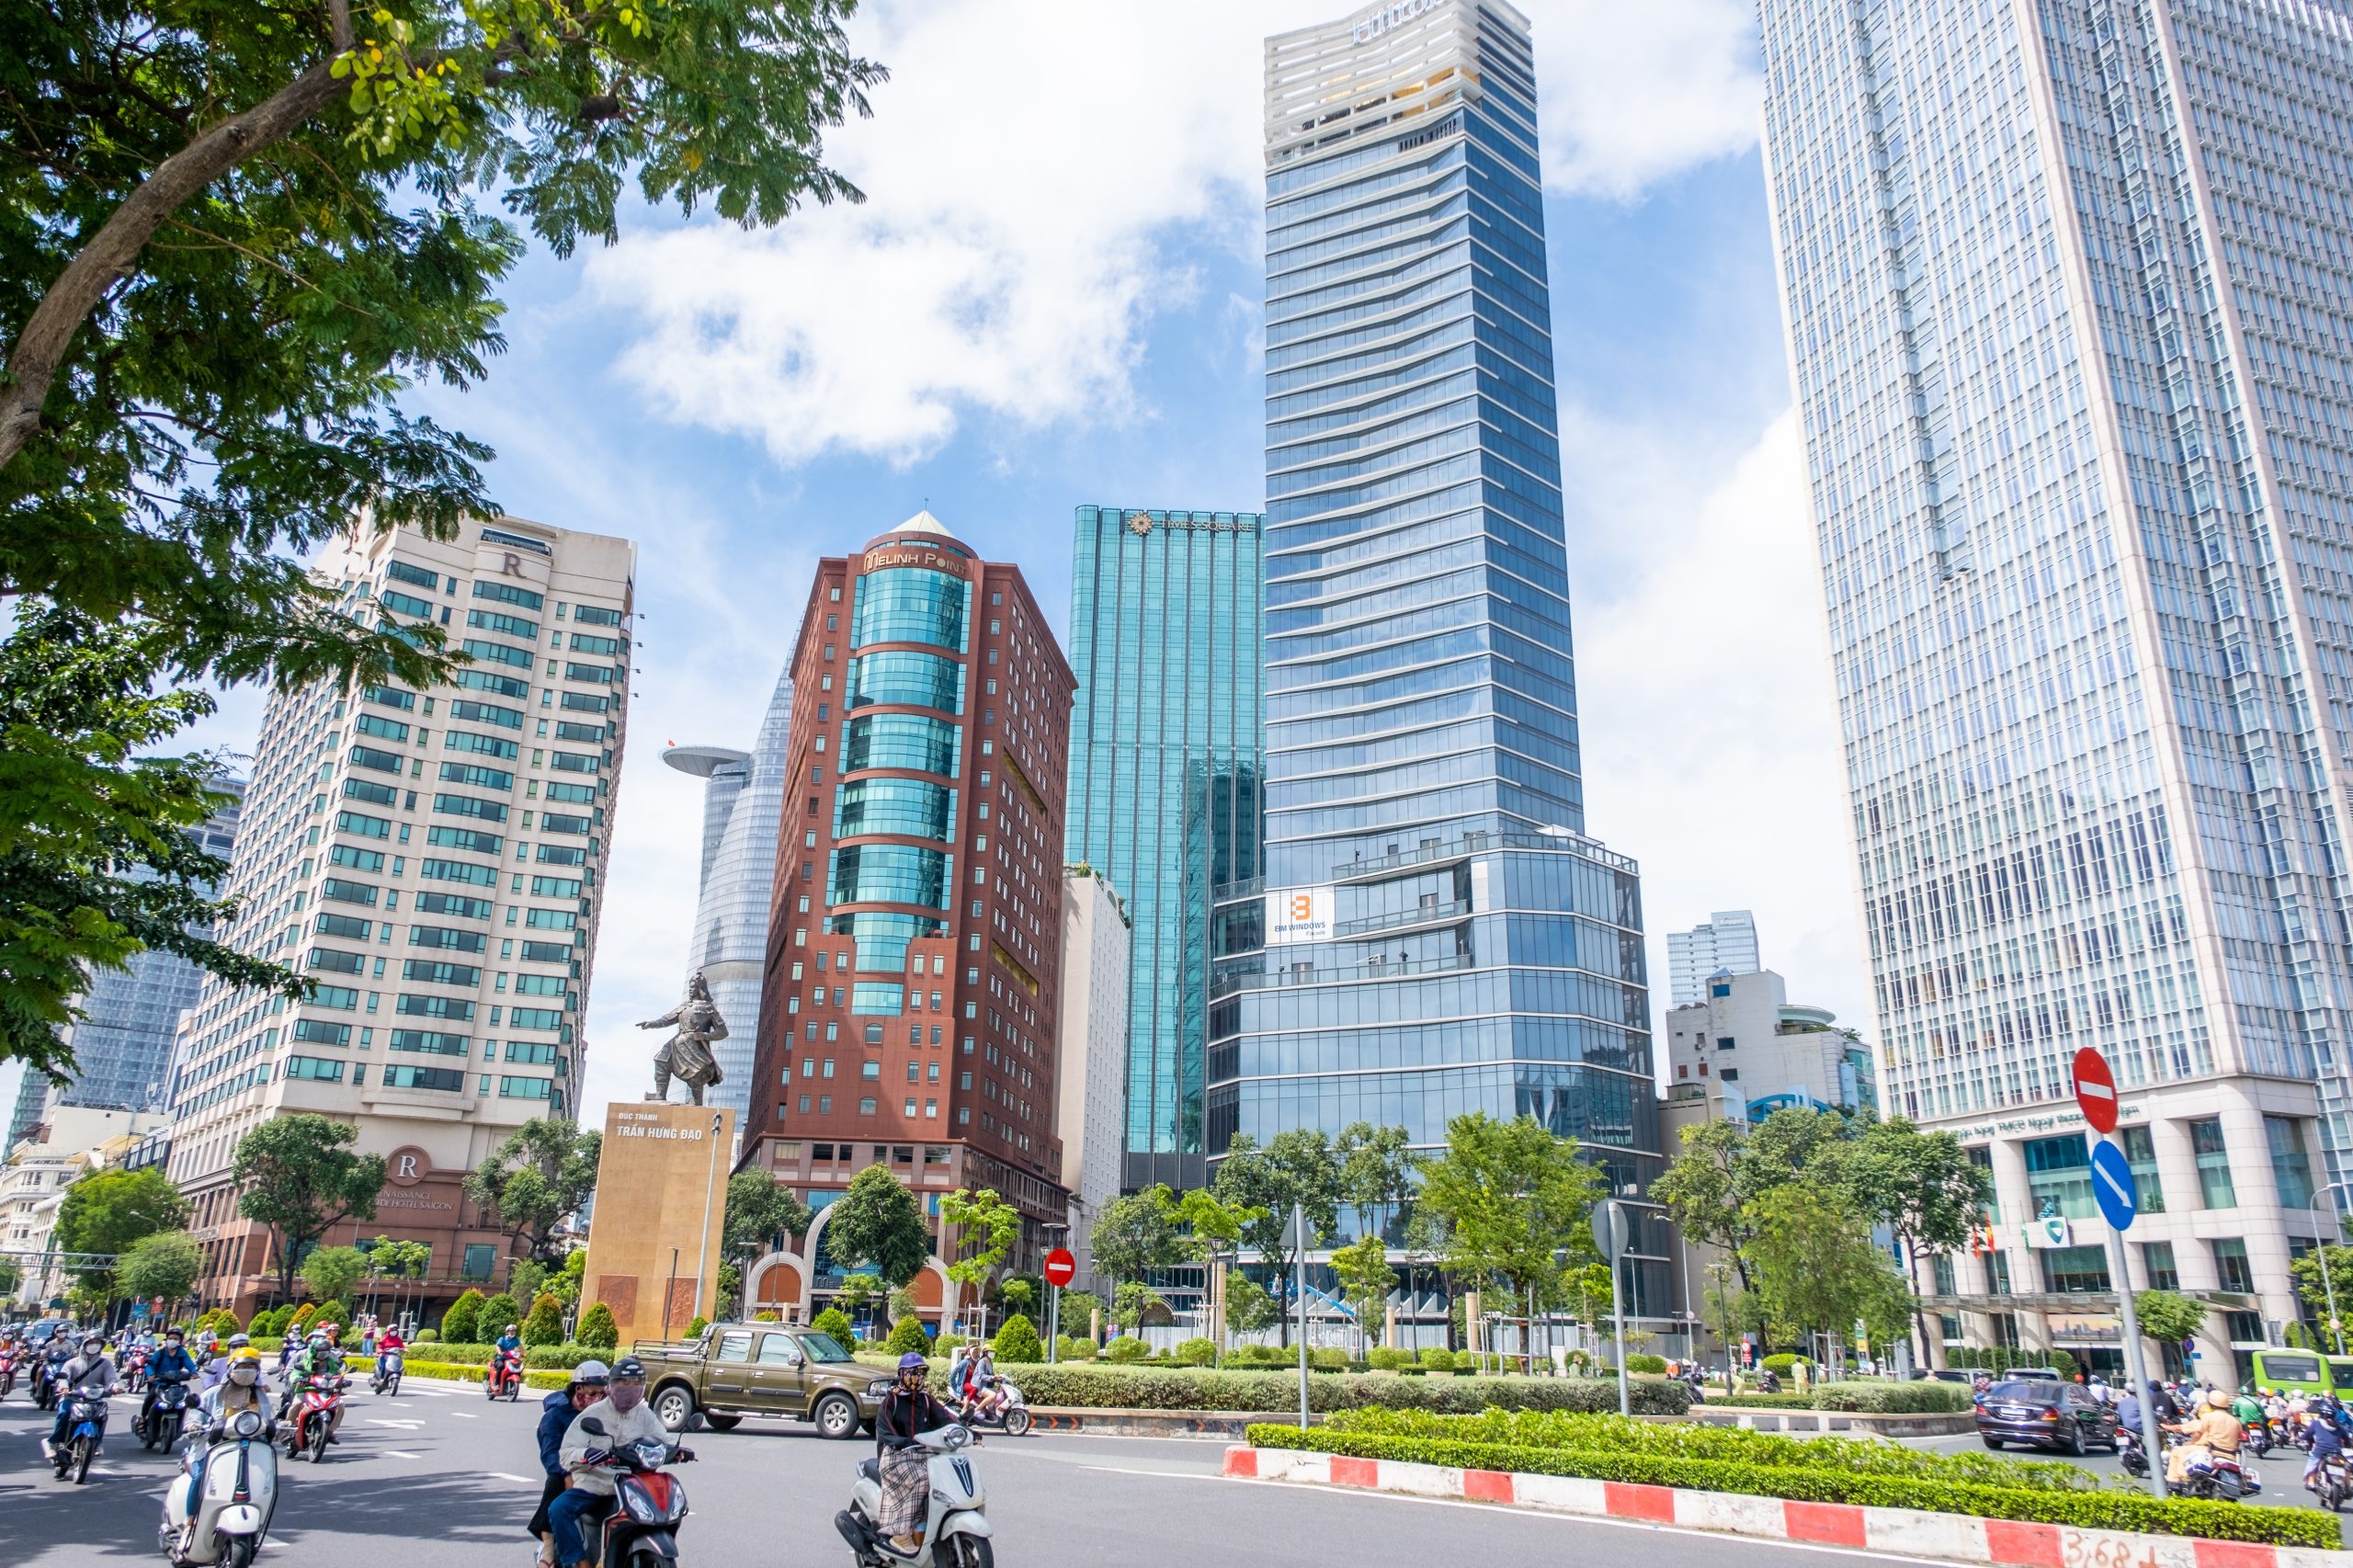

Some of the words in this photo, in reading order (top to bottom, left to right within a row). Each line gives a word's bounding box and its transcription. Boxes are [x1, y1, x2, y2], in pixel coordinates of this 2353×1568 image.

[1162, 519, 1198, 529] TIMES
[1202, 520, 1253, 532] SQUARE
[501, 551, 527, 579] R
[1289, 921, 1326, 931] WINDOWS
[648, 1126, 677, 1140] HƯNG
[680, 1129, 702, 1142] ĐẠO
[397, 1154, 420, 1178] R
[377, 1189, 432, 1200] ENAISSANCE
[391, 1199, 419, 1210] HOTEL
[419, 1201, 453, 1210] SAIGON
